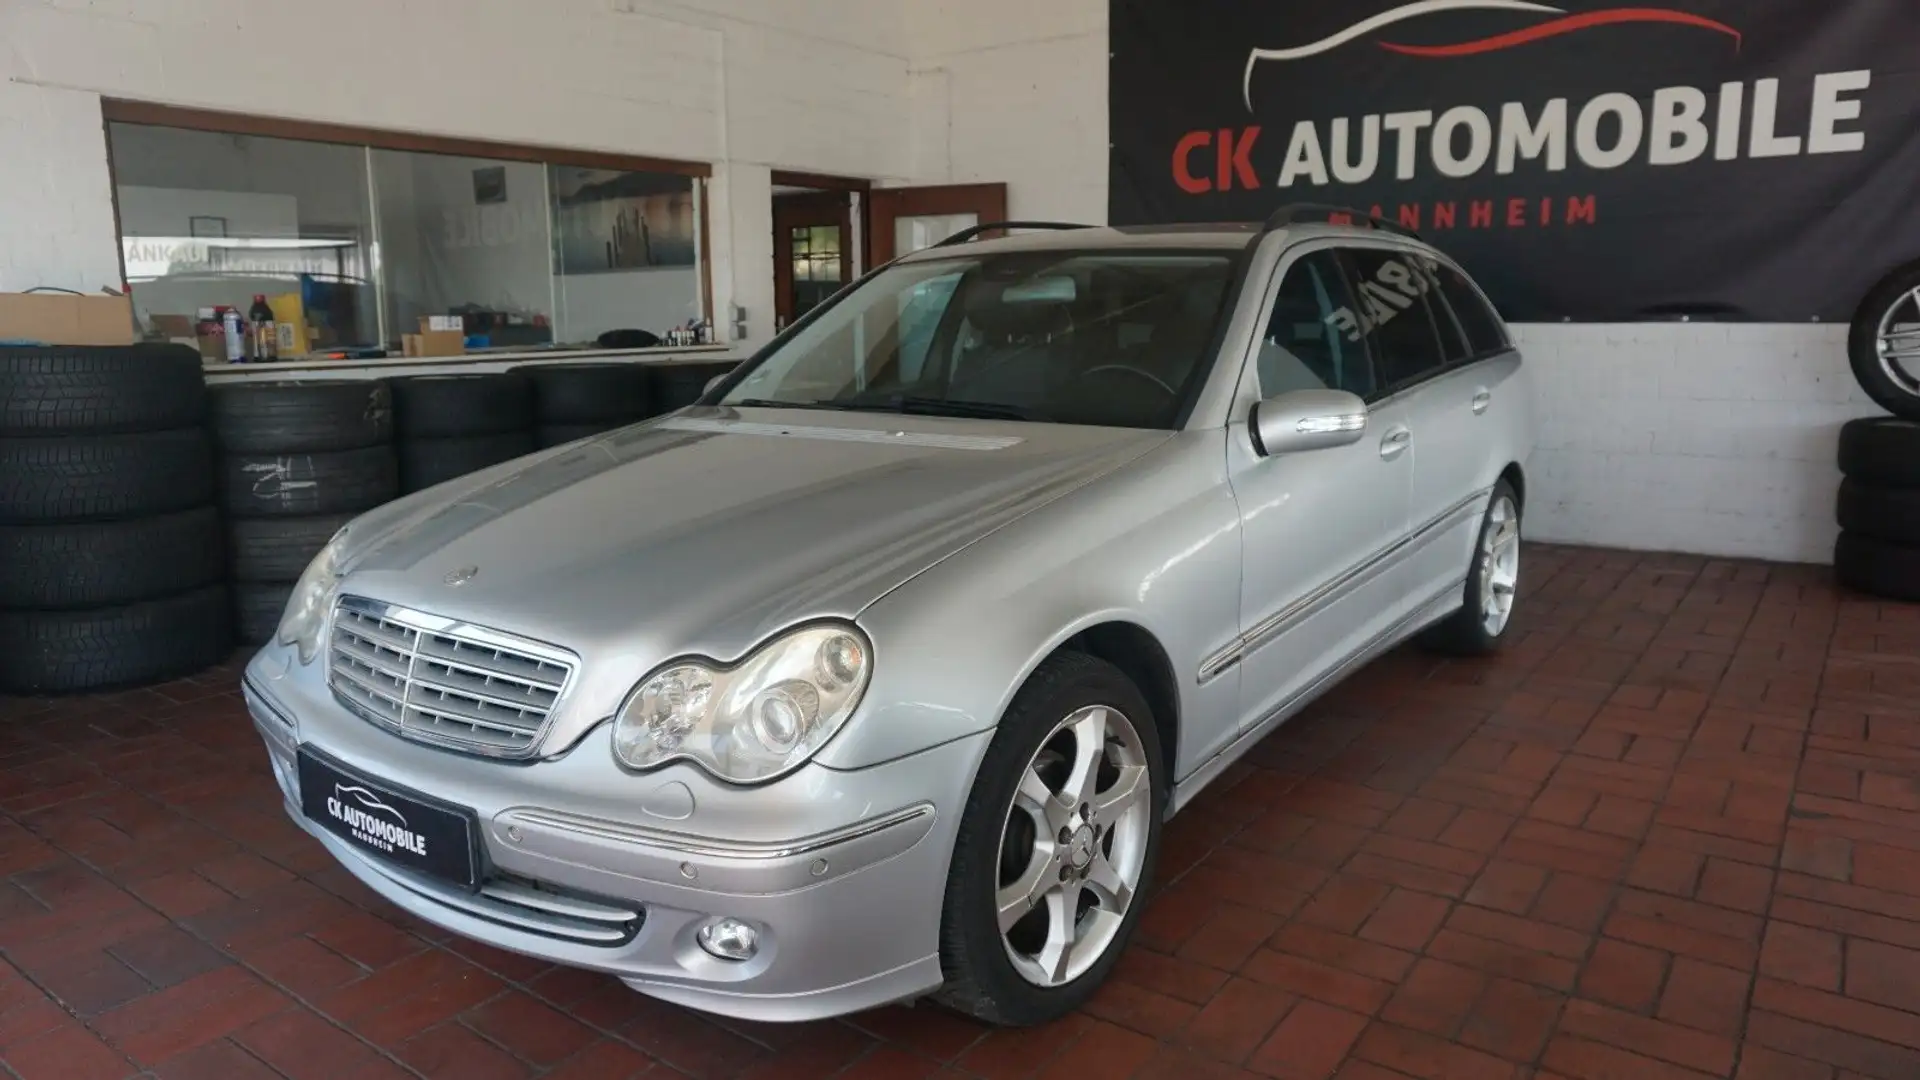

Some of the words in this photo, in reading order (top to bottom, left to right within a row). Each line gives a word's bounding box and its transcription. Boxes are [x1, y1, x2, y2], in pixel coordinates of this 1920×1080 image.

[1172, 127, 1260, 193] CK
[1278, 70, 1871, 188] AUTOMOBILE
[328, 797, 342, 820] CK
[343, 805, 426, 856] AUTOMOBILE
